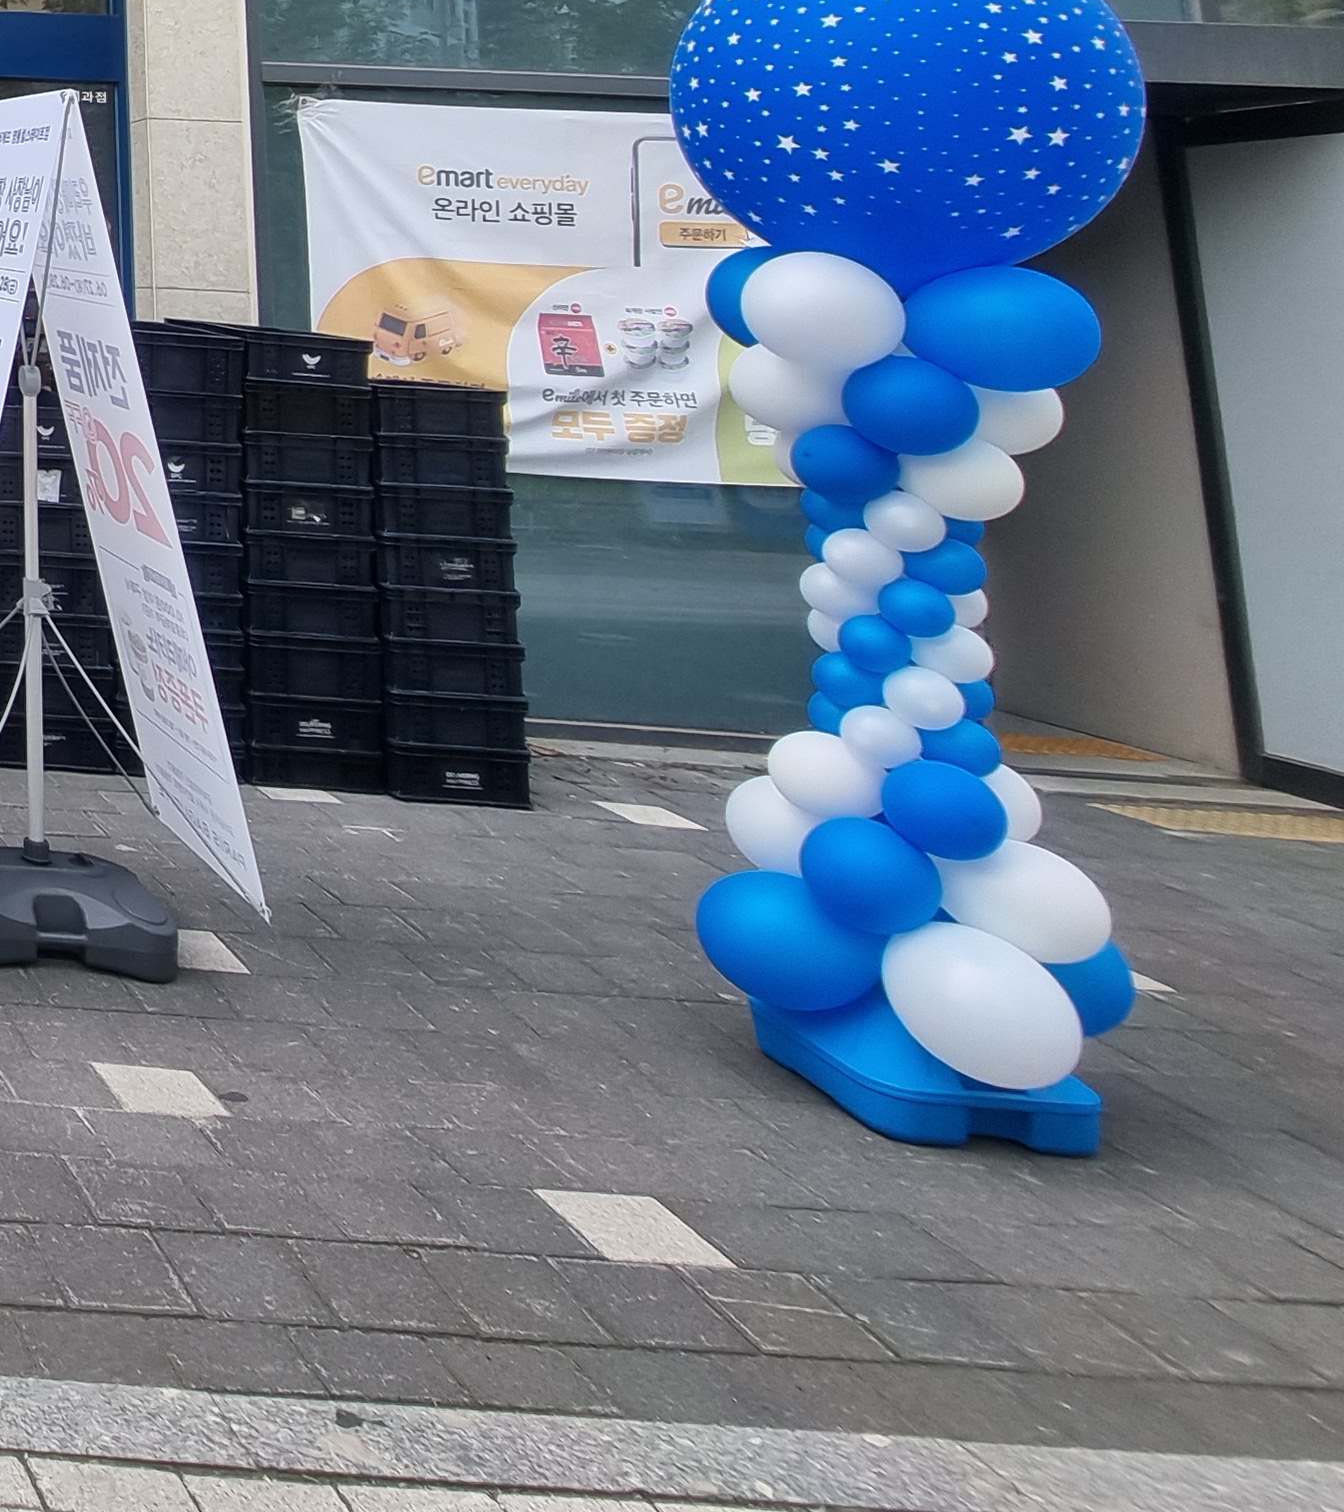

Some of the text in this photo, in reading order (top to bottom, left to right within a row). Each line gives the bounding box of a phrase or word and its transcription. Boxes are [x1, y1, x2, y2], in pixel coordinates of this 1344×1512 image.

[76, 92, 107, 104] 과점
[417, 164, 589, 196] emart everyday
[431, 196, 578, 227] 온라인 쇼핑몰
[679, 227, 727, 242] 주문하기
[551, 336, 577, 370] 辛
[611, 390, 626, 407] 첫
[630, 391, 699, 409] 주문하면
[551, 411, 688, 445] 모두 증정
